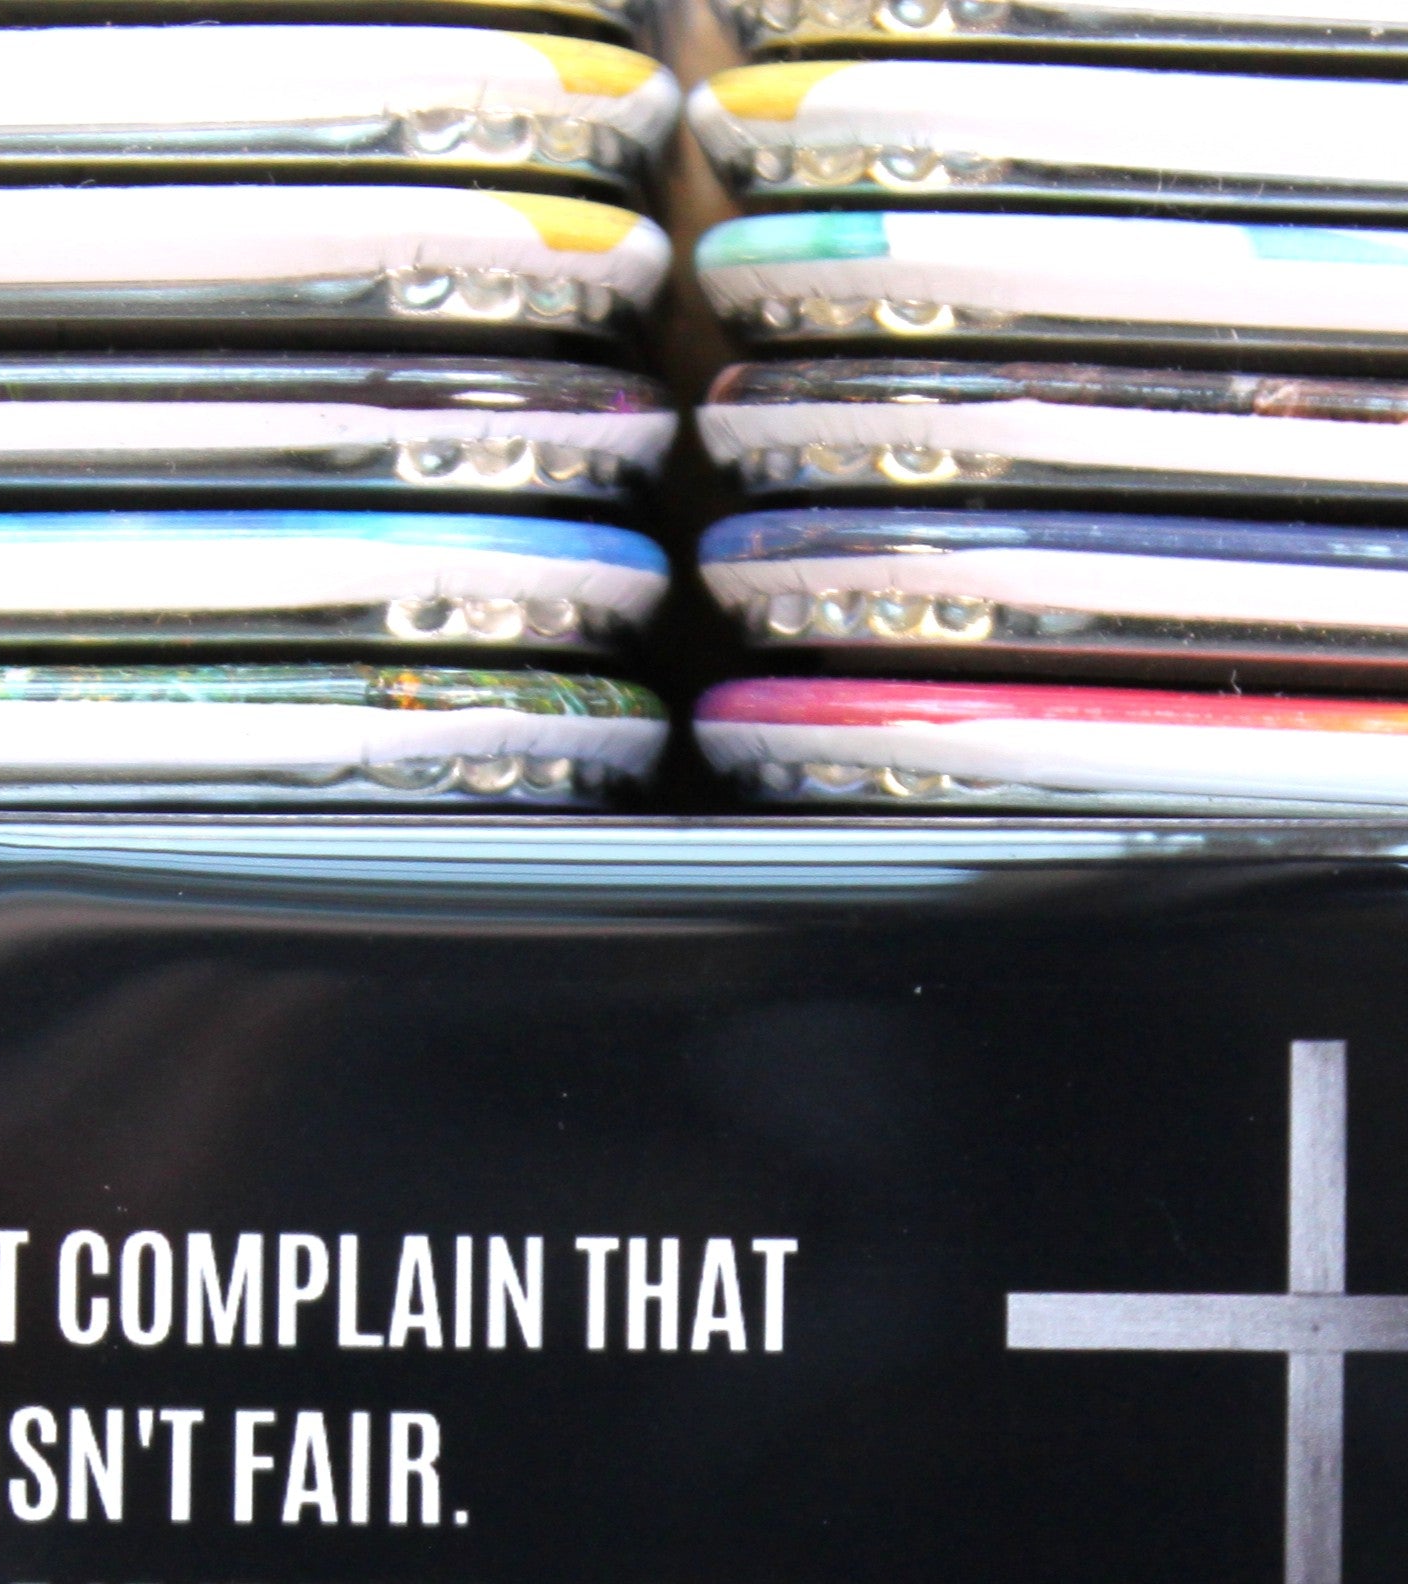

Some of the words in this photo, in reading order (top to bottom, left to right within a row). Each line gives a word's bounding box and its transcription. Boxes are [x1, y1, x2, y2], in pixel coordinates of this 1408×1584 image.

[58, 1229, 543, 1349] COMPLAIN
[575, 1236, 798, 1352] THAT
[234, 1410, 468, 1525] FAIR.
